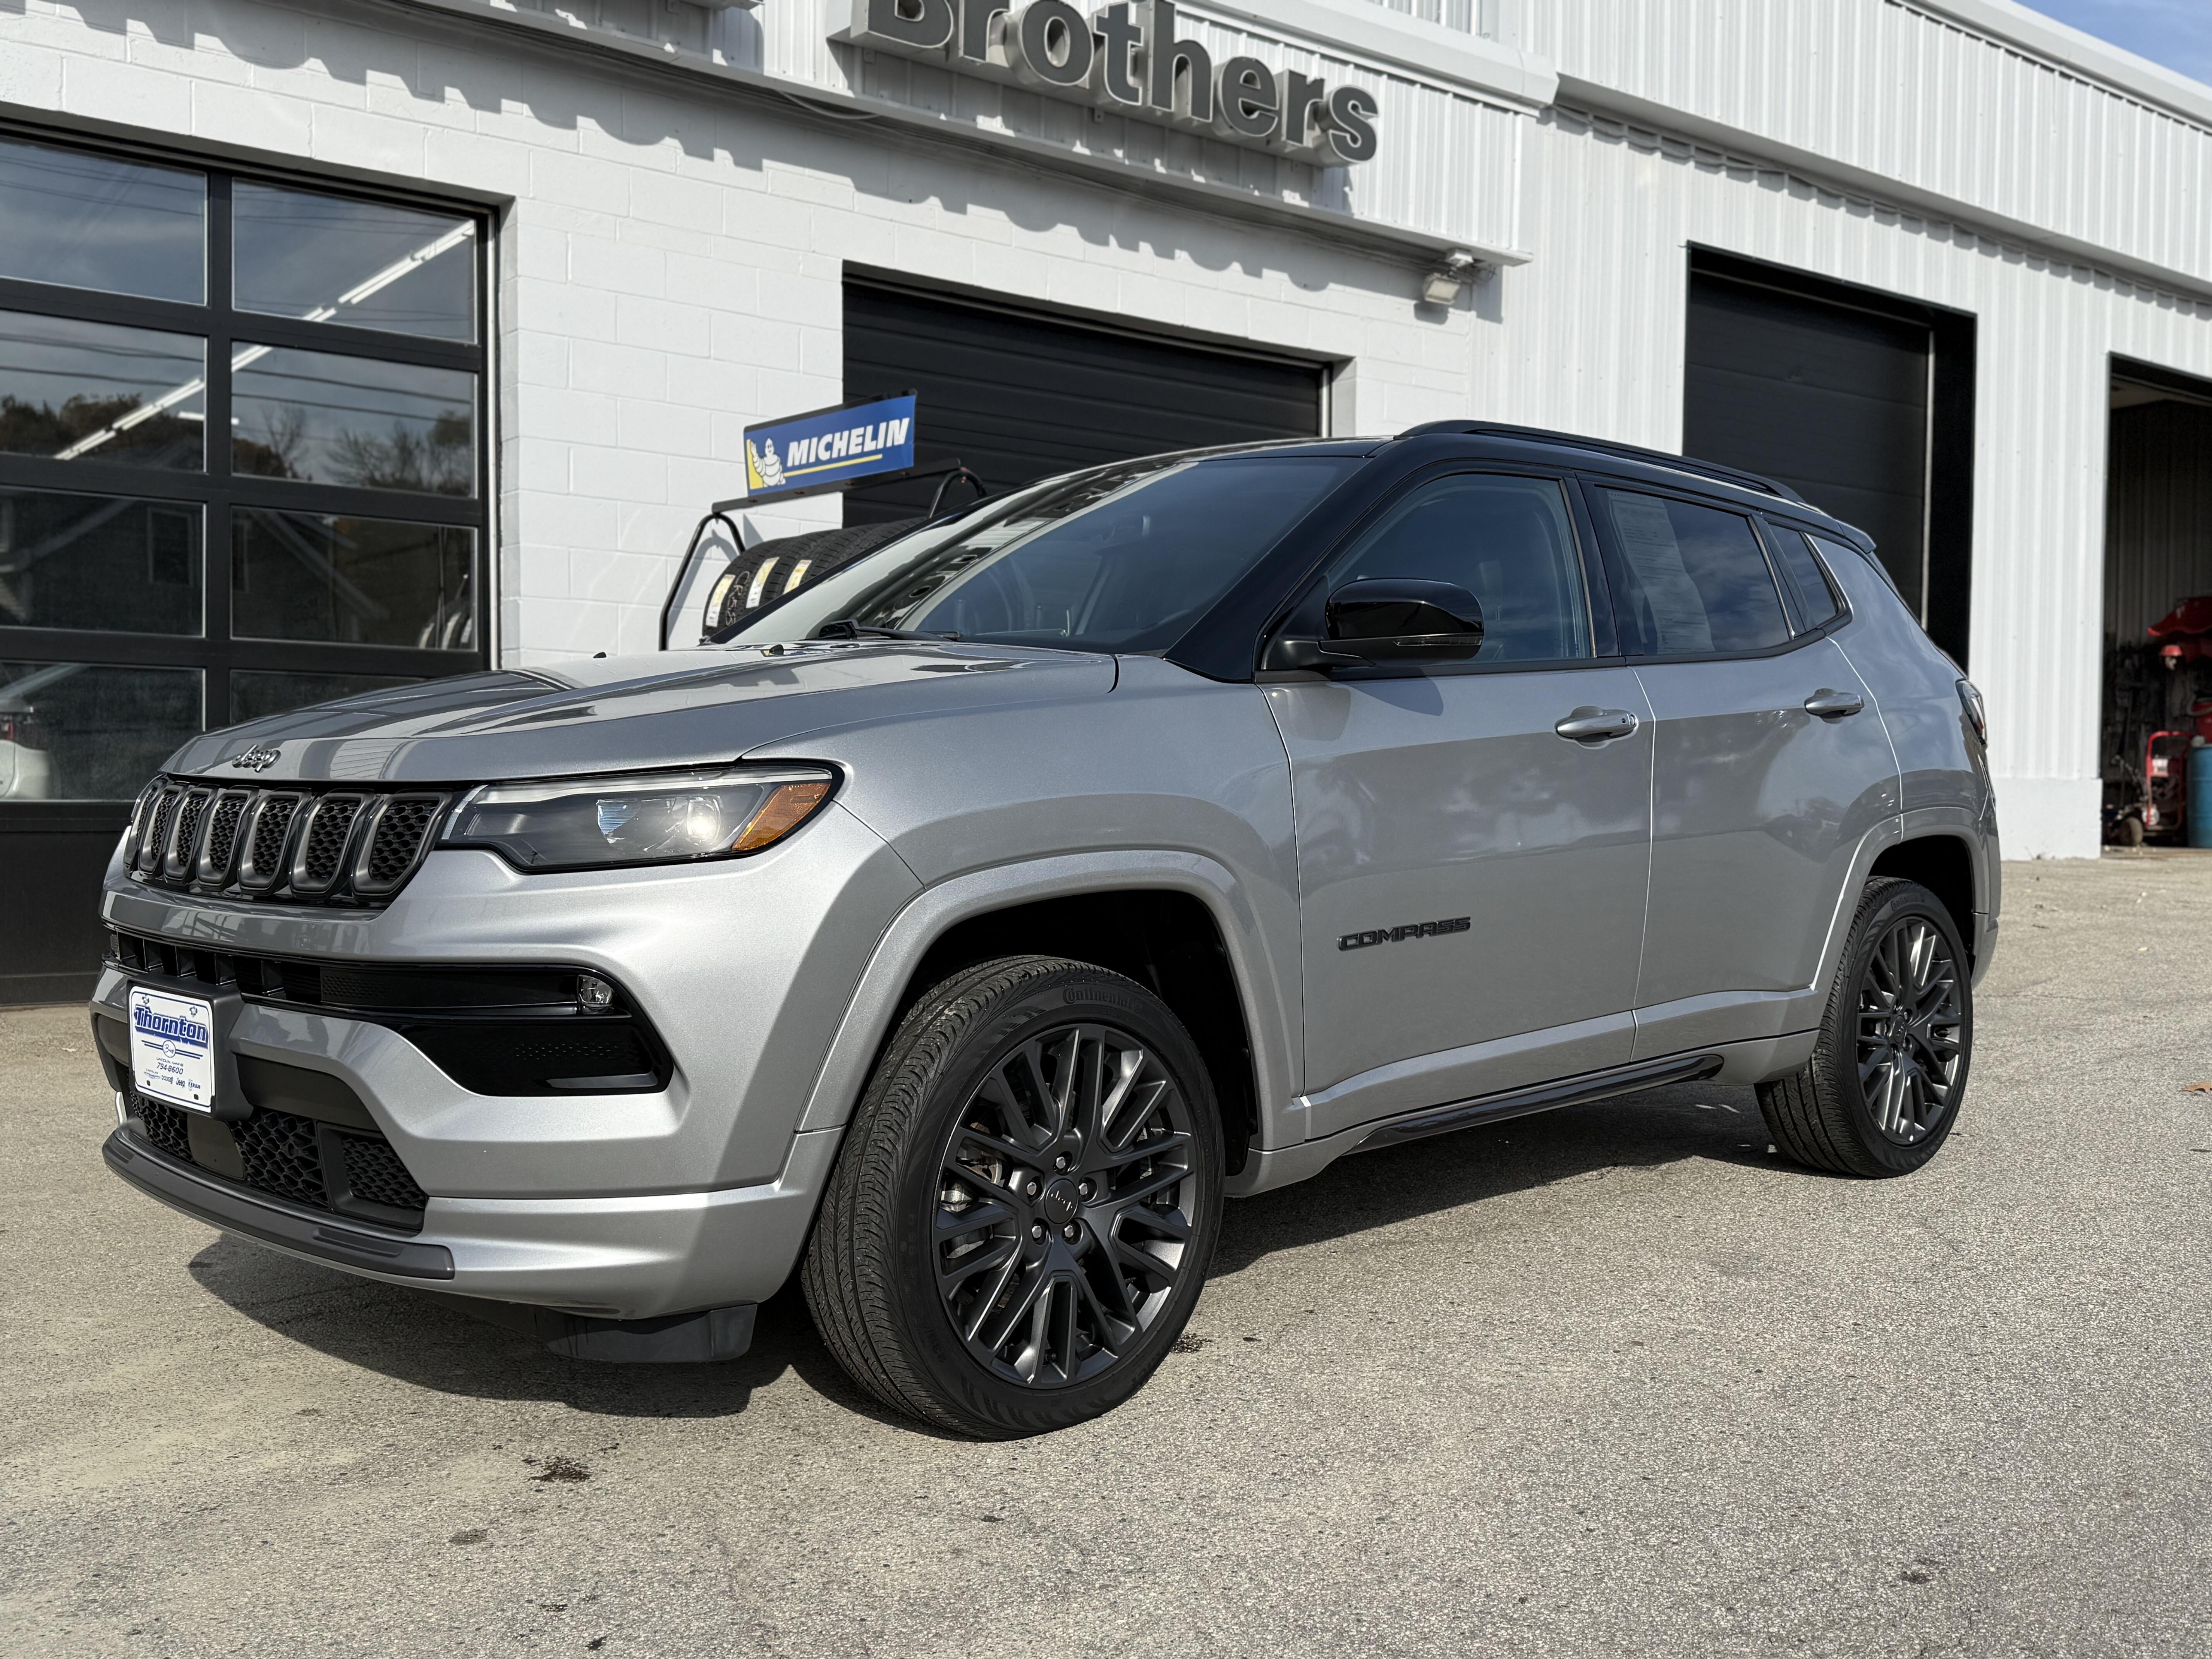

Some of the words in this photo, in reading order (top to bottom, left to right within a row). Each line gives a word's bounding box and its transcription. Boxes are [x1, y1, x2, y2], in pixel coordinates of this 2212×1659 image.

[787, 417, 910, 467] MICHELIN
[232, 744, 281, 773] Jeep
[1337, 916, 1471, 951] COMPASS
[134, 1005, 208, 1046] Thornton
